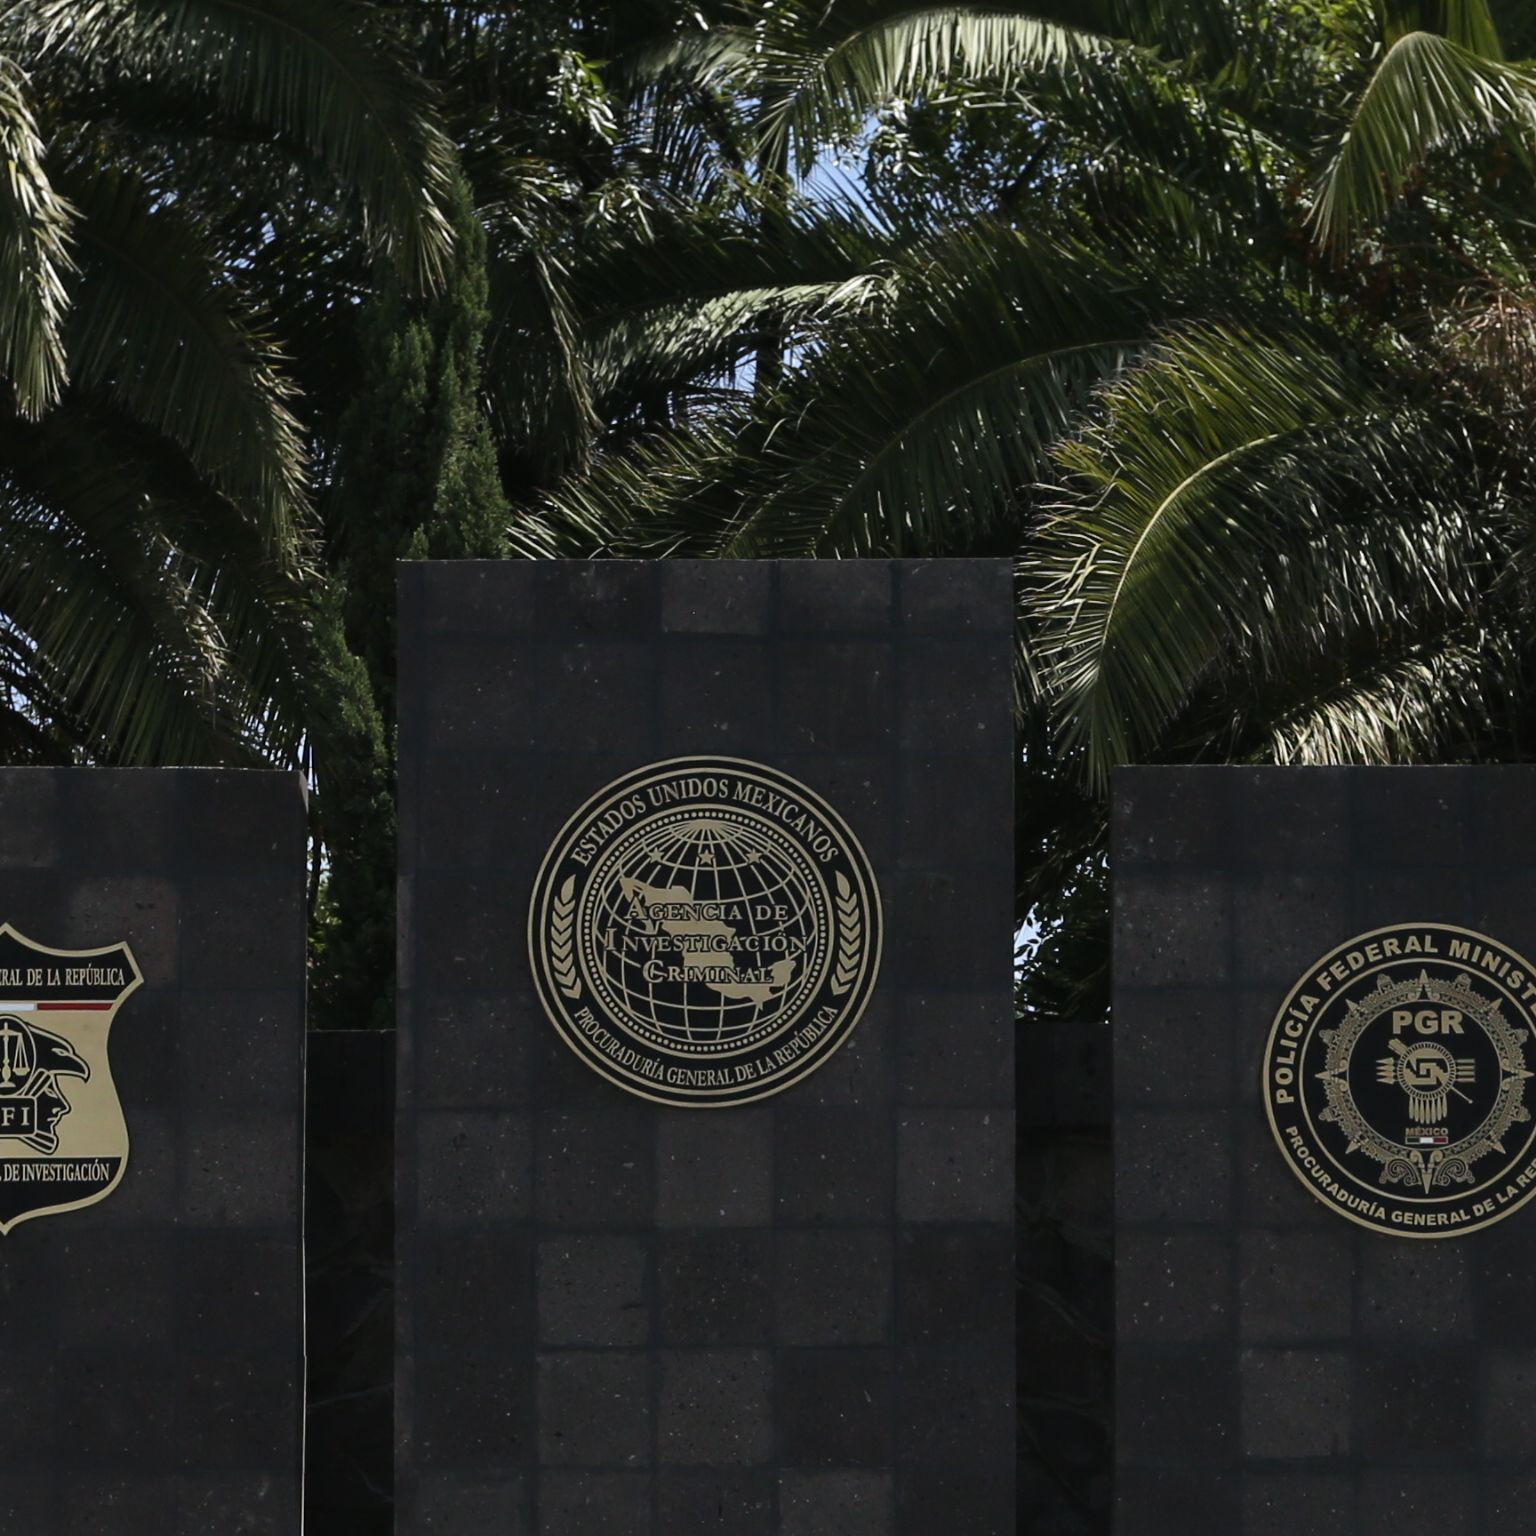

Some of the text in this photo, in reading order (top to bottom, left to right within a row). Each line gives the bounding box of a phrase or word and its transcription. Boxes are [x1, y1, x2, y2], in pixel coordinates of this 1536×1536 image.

[569, 777, 842, 867] ESTADOS UNIDOS MEXICANOS
[623, 895, 790, 922] AGENCIA DE
[604, 925, 809, 953] INVESTIGACIÓN
[26, 967, 43, 986] DE
[46, 967, 62, 987] LA
[64, 962, 126, 986] REPÚBLICA
[642, 959, 775, 984] CRIMINAL
[1274, 992, 1321, 1105] POLICÍA
[1316, 934, 1439, 992] FEDERAL
[1391, 1010, 1465, 1035] PGR
[573, 1004, 840, 1087] PROCURADURÍA GENERAL DE LA REPÚBLICA
[2, 1163, 21, 1183] DE
[21, 1158, 111, 1183] INVESTIGACIÓN
[1284, 1125, 1386, 1220] PROCURADURÍA
[1390, 1206, 1471, 1227] GENERAL
[1471, 1197, 1496, 1217] DE
[1496, 1184, 1520, 1204] LA
